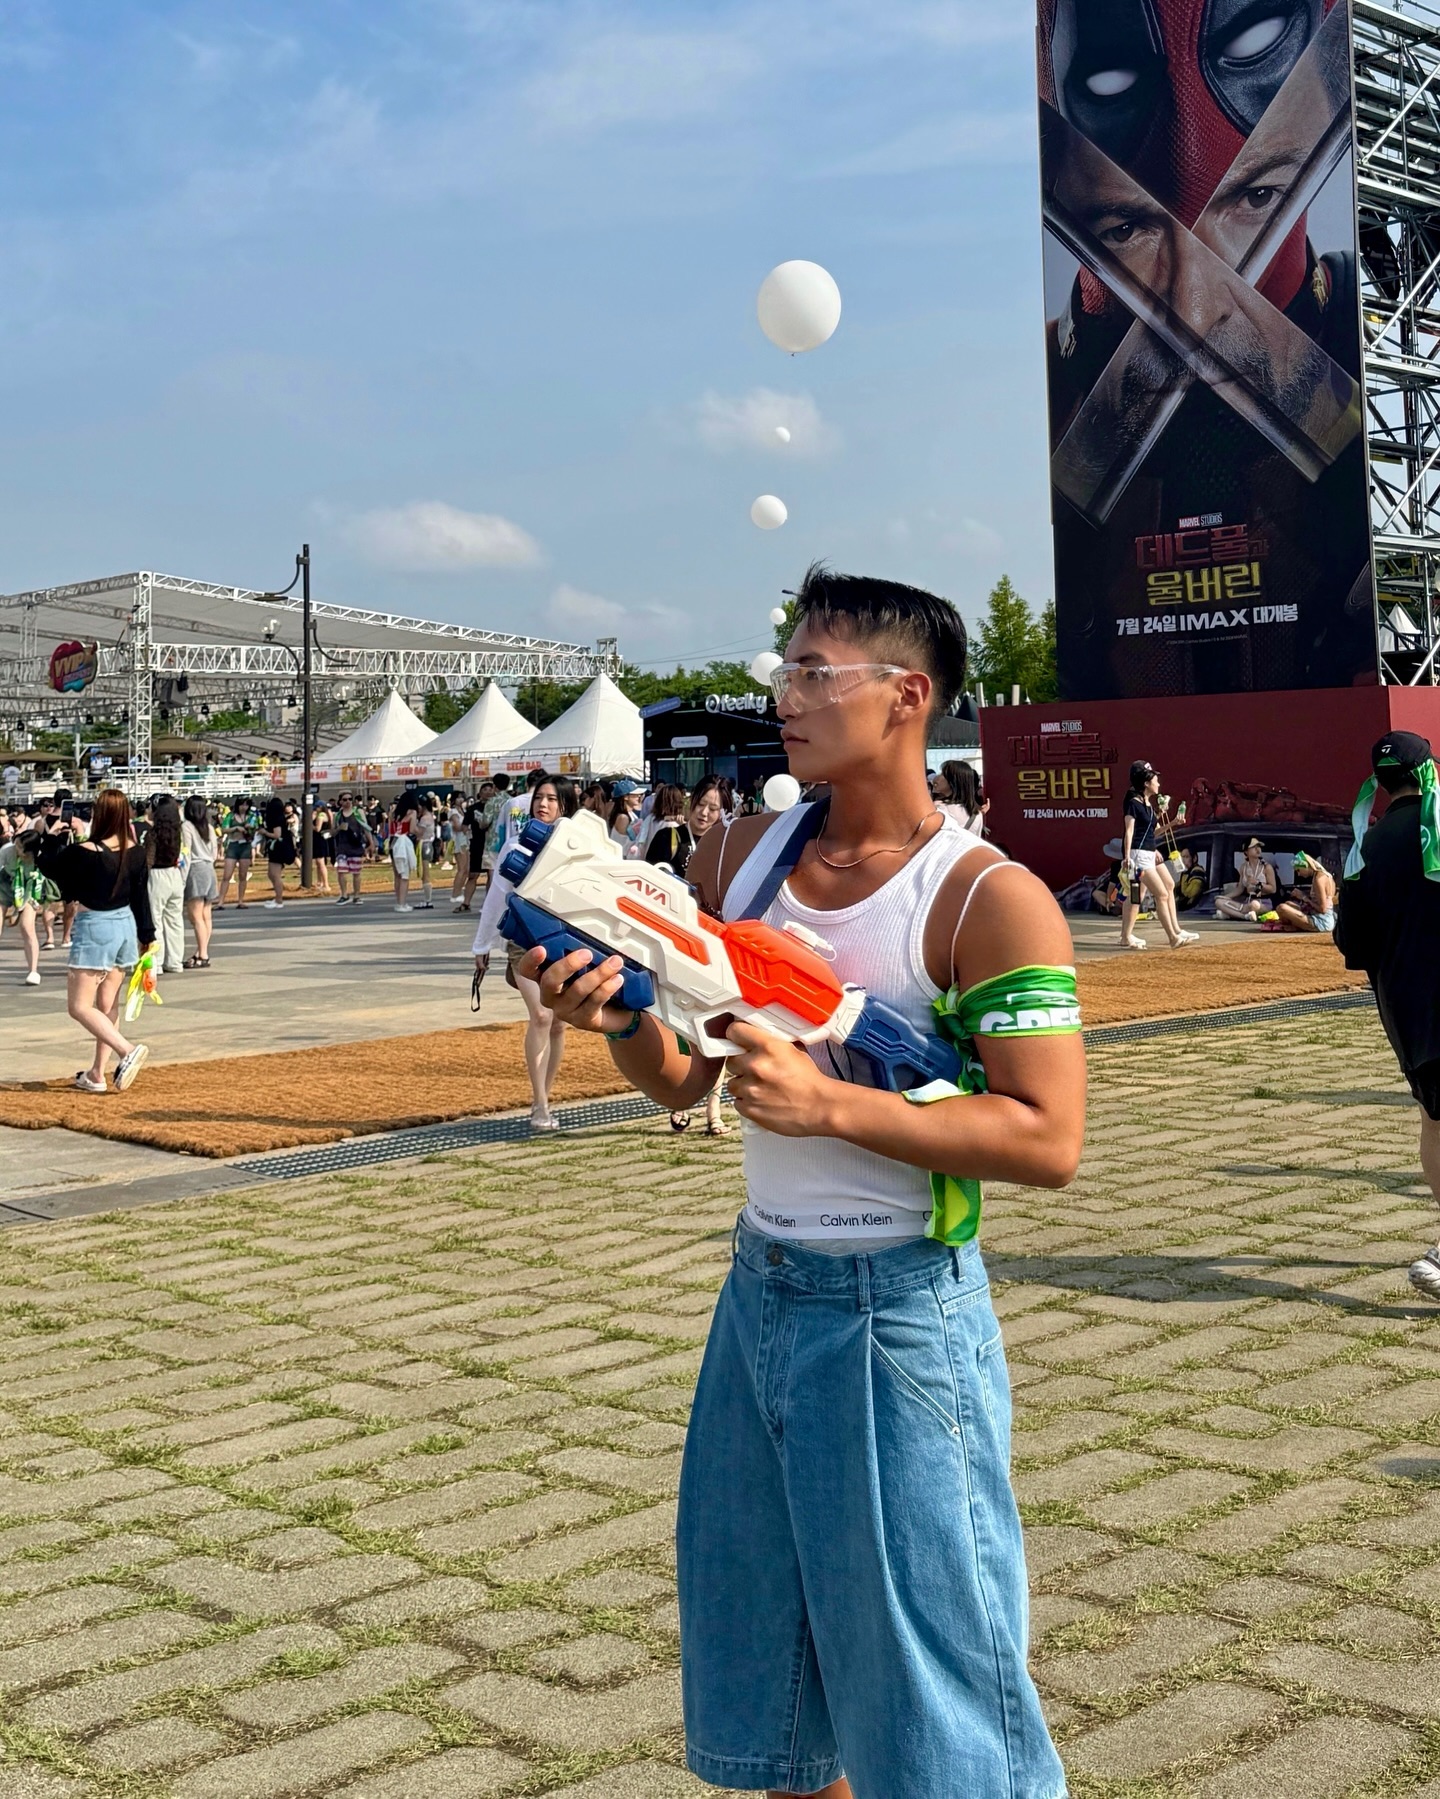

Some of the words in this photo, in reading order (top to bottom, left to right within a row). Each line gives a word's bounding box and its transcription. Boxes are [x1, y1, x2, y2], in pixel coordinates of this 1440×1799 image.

[1179, 516, 1200, 529] MARVEL
[1200, 512, 1223, 526] STUDIOS
[1146, 561, 1262, 606] 울버린
[1116, 618, 1140, 636] 7월
[1143, 615, 1176, 633] 24일
[1180, 609, 1249, 631] IMAX
[1253, 603, 1298, 624] 대개봉
[1040, 722, 1061, 733] MARVEL
[1061, 720, 1082, 732] STUDIOS
[1017, 768, 1111, 800] 울버린
[1054, 809, 1085, 818] IMAX
[754, 1204, 774, 1224] Calvin
[774, 1214, 797, 1228] Klein
[820, 1213, 860, 1227] Calvin
[861, 1212, 893, 1226] Klein
